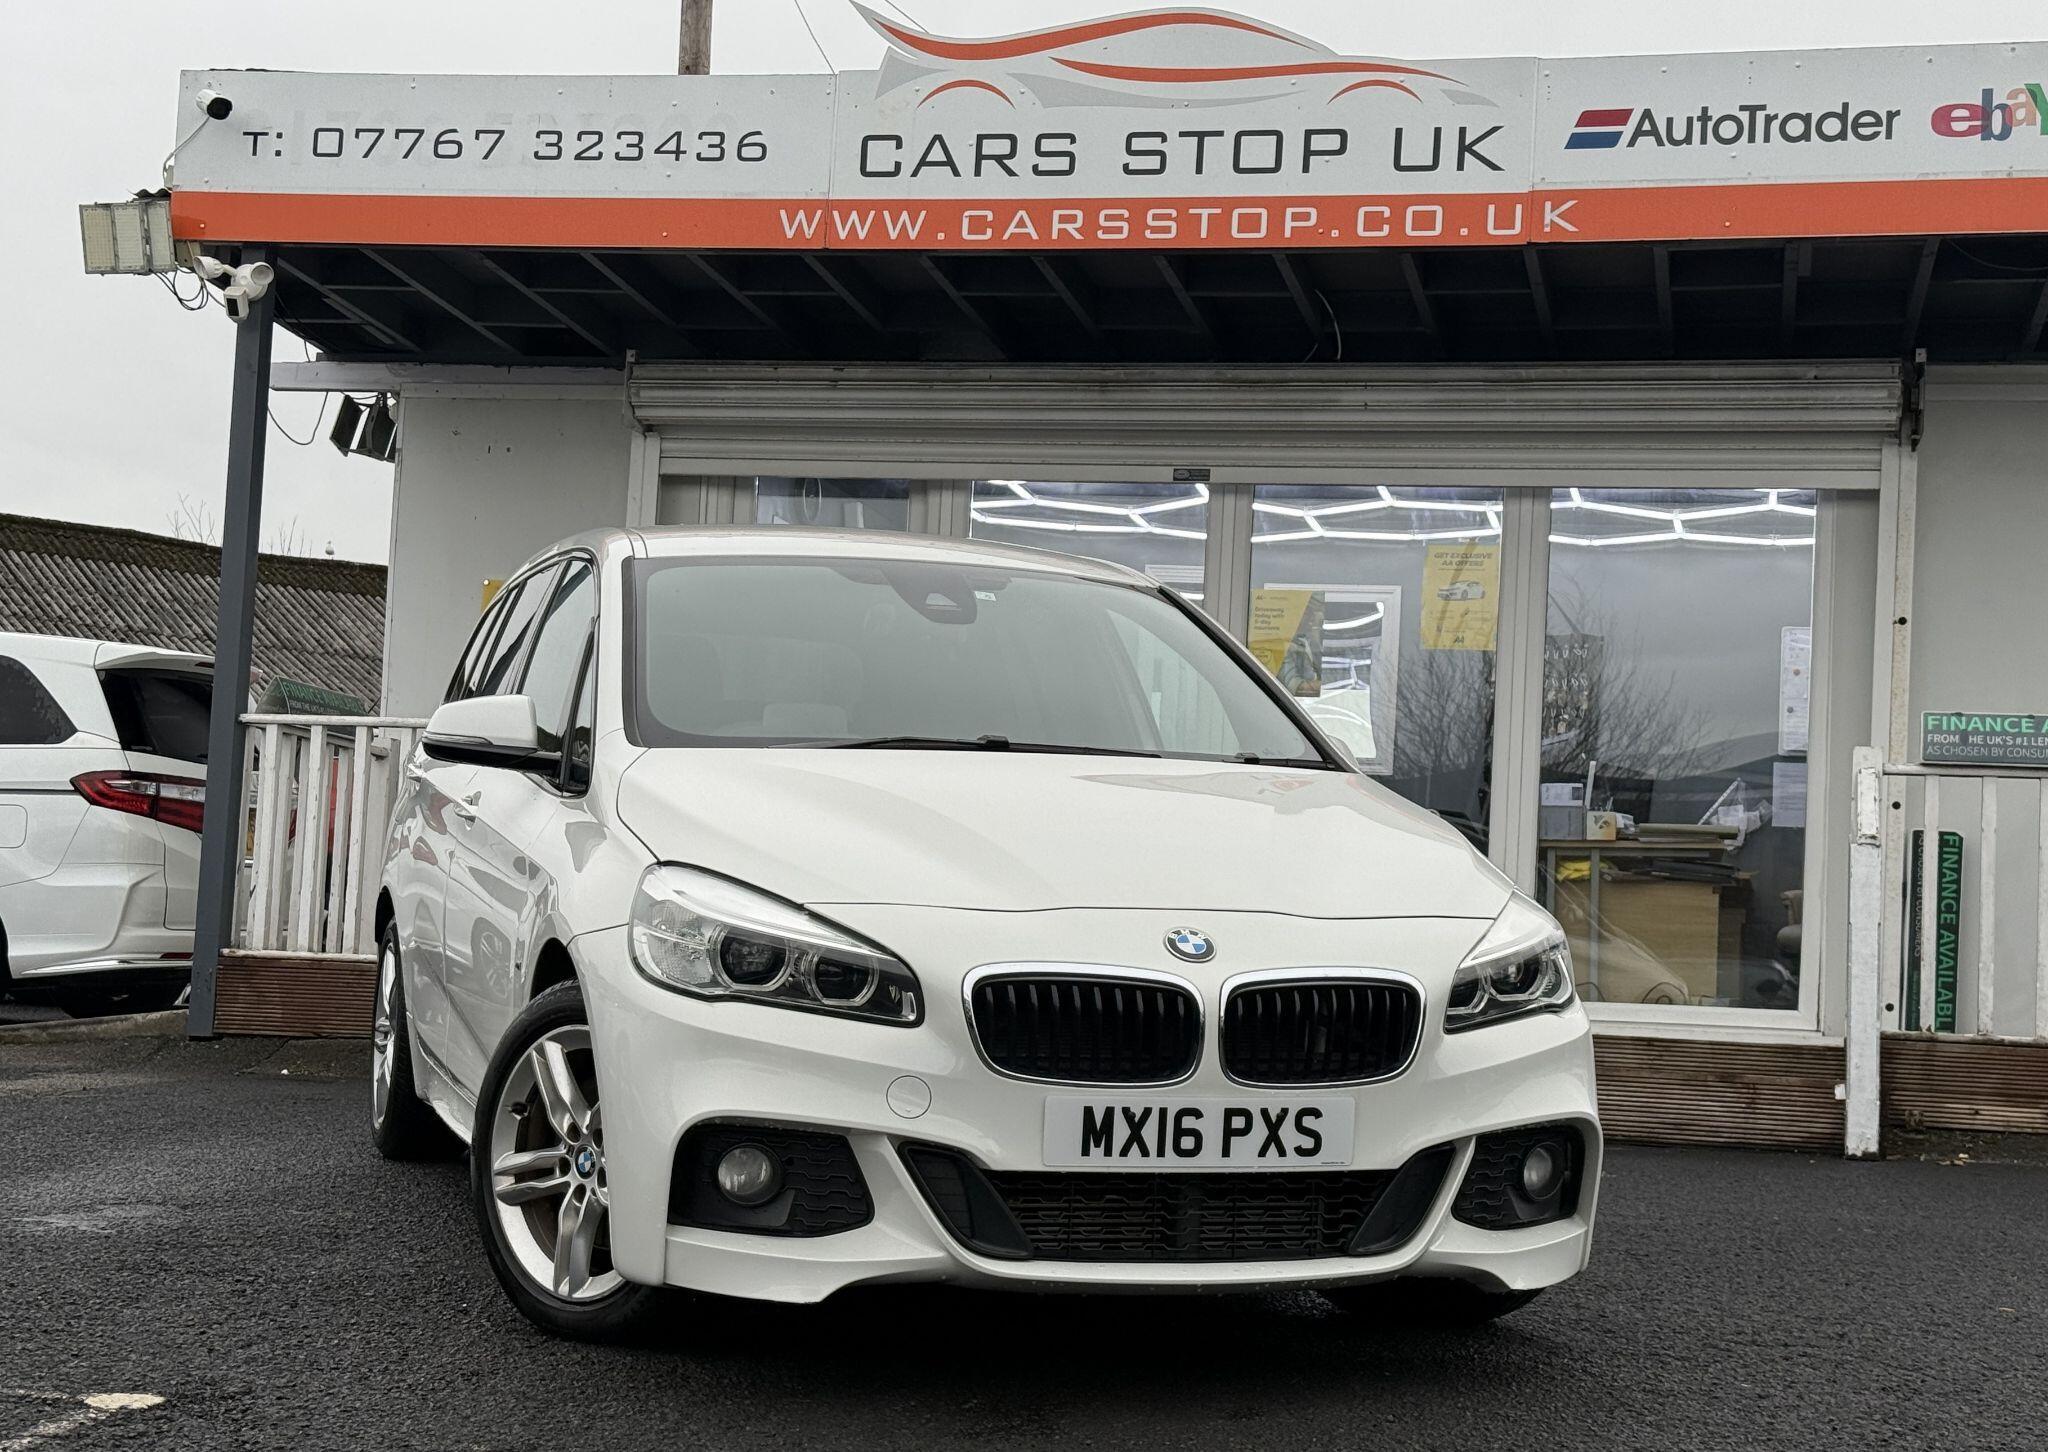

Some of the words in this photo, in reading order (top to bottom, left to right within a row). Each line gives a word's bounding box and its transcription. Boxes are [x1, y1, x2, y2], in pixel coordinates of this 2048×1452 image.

[242, 131, 283, 157] T:
[312, 127, 506, 160] 07767
[533, 129, 768, 162] 323436
[1627, 102, 1900, 148] AutoTrader
[859, 132, 1077, 178] CARS
[1122, 128, 1348, 176] STOP
[1393, 125, 1507, 173] UK
[779, 200, 1580, 241] WWW.CARSSTOP.CO.UK
[1927, 716, 2035, 733] FINANCE
[1927, 734, 1959, 744] FROM
[1965, 735, 1984, 745] HE
[1986, 735, 2014, 746] UK'S
[1926, 745, 1940, 755] AS
[1942, 746, 1988, 757] CHOSEN
[1991, 747, 2004, 757] BY
[2006, 748, 2048, 758] CONSU
[1939, 834, 1960, 925] FINANCE
[1936, 928, 1956, 1032] AVAILABL
[1081, 1105, 1204, 1158] MX16
[1221, 1106, 1324, 1158] PXS
